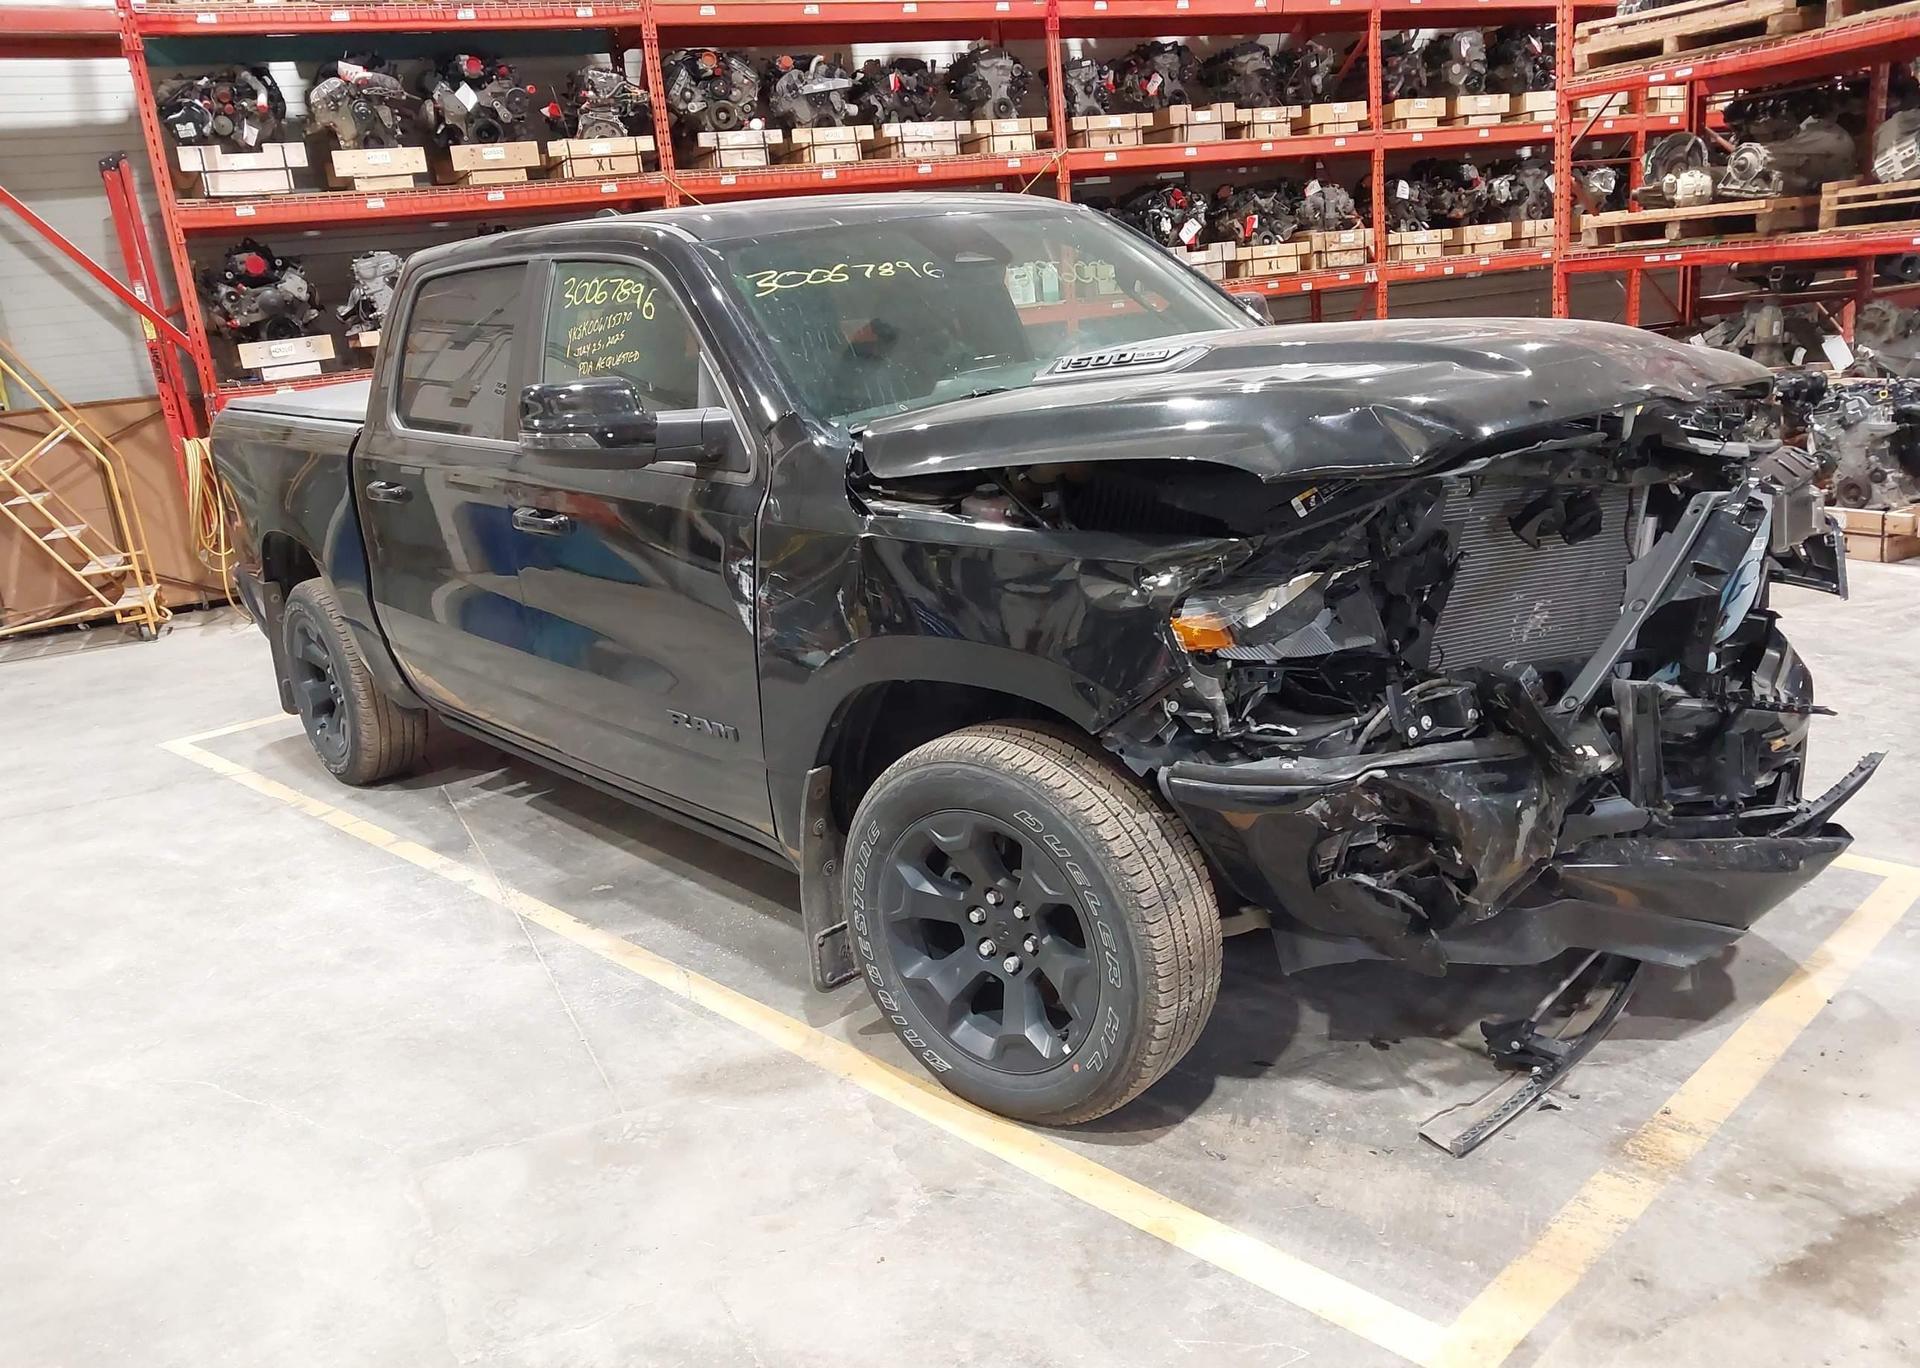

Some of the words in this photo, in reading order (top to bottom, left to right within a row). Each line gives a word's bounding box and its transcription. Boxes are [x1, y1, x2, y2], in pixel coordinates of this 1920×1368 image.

[563, 277, 657, 320] 30067896
[746, 261, 945, 297] 30067896
[1061, 352, 1134, 369] 1500
[666, 708, 740, 742] RAM
[1013, 808, 1123, 990] DUELER
[849, 818, 953, 1073] BRIDGESTONE
